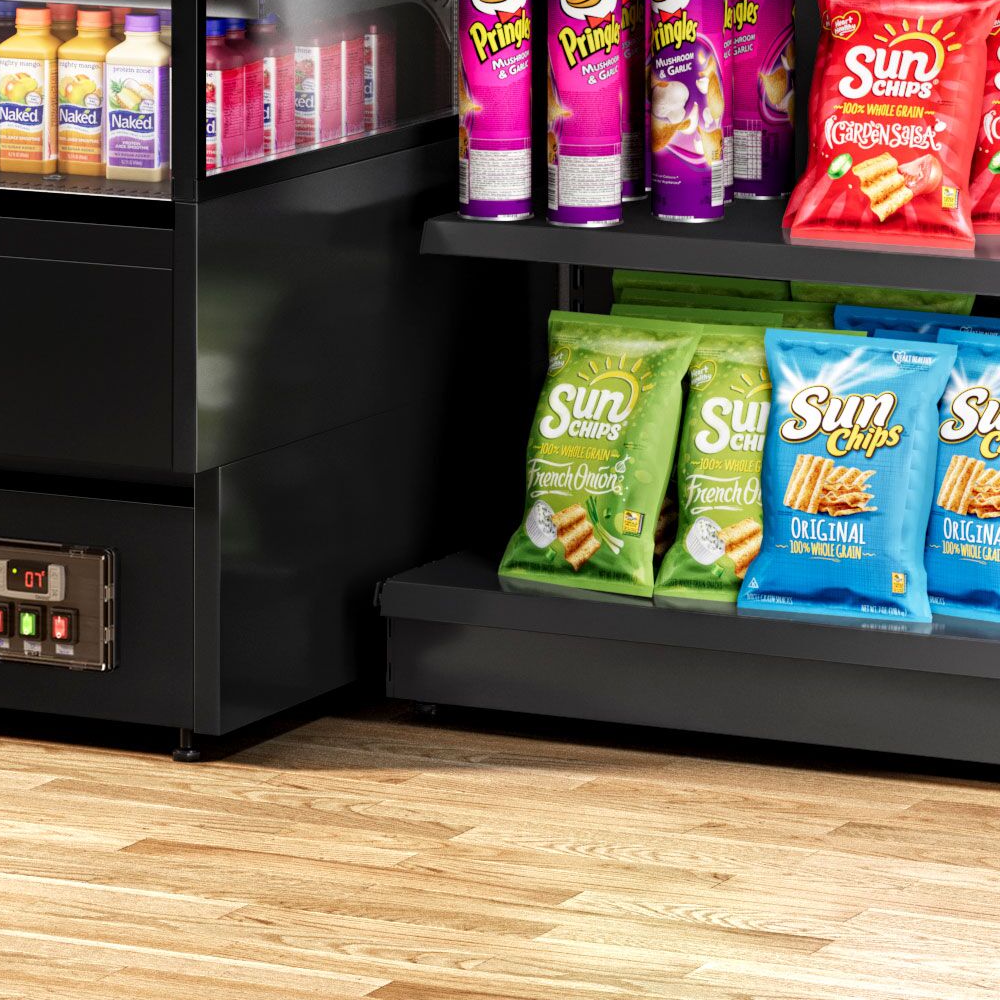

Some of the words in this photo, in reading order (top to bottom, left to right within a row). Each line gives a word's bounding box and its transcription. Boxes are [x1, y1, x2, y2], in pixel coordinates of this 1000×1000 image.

[834, 16, 854, 28] Heart
[469, 9, 531, 64] Pringles
[558, 14, 621, 69] Pringles
[19, 61, 41, 69] mango
[79, 63, 99, 71] mango
[656, 52, 695, 69] MUSHROOM
[498, 69, 507, 80] &
[508, 62, 530, 77] GARLIC
[587, 75, 597, 85] &
[598, 67, 619, 82] GARLIC
[659, 67, 667, 79] &
[668, 62, 693, 76] GARLIC
[838, 45, 938, 99] Sun
[872, 79, 932, 99] CHIPS
[0, 106, 38, 122] Naked
[59, 108, 97, 124] Naked
[841, 103, 866, 115] 100%
[867, 103, 896, 117] WHOLE
[896, 105, 924, 118] GRAIN
[112, 113, 152, 129] Naked
[539, 383, 632, 439] Sun
[779, 385, 898, 444] Sun
[568, 420, 622, 441] CHIPS
[826, 424, 904, 458] Chips
[539, 443, 560, 455] 100%
[561, 445, 586, 459] WHOLE
[586, 447, 611, 461] GRAIN
[700, 458, 722, 470] 100%
[723, 460, 754, 472] WHOLE
[528, 458, 574, 490] French
[573, 463, 622, 494] Onion
[685, 474, 742, 507] French
[791, 516, 866, 545] ORIGINAL
[944, 518, 1000, 545] ORIGINA
[789, 540, 811, 555] 100%
[811, 542, 836, 557] WHOLE
[836, 544, 863, 560] GRAIN
[942, 542, 960, 556] 100%
[961, 543, 981, 559] WHOLE
